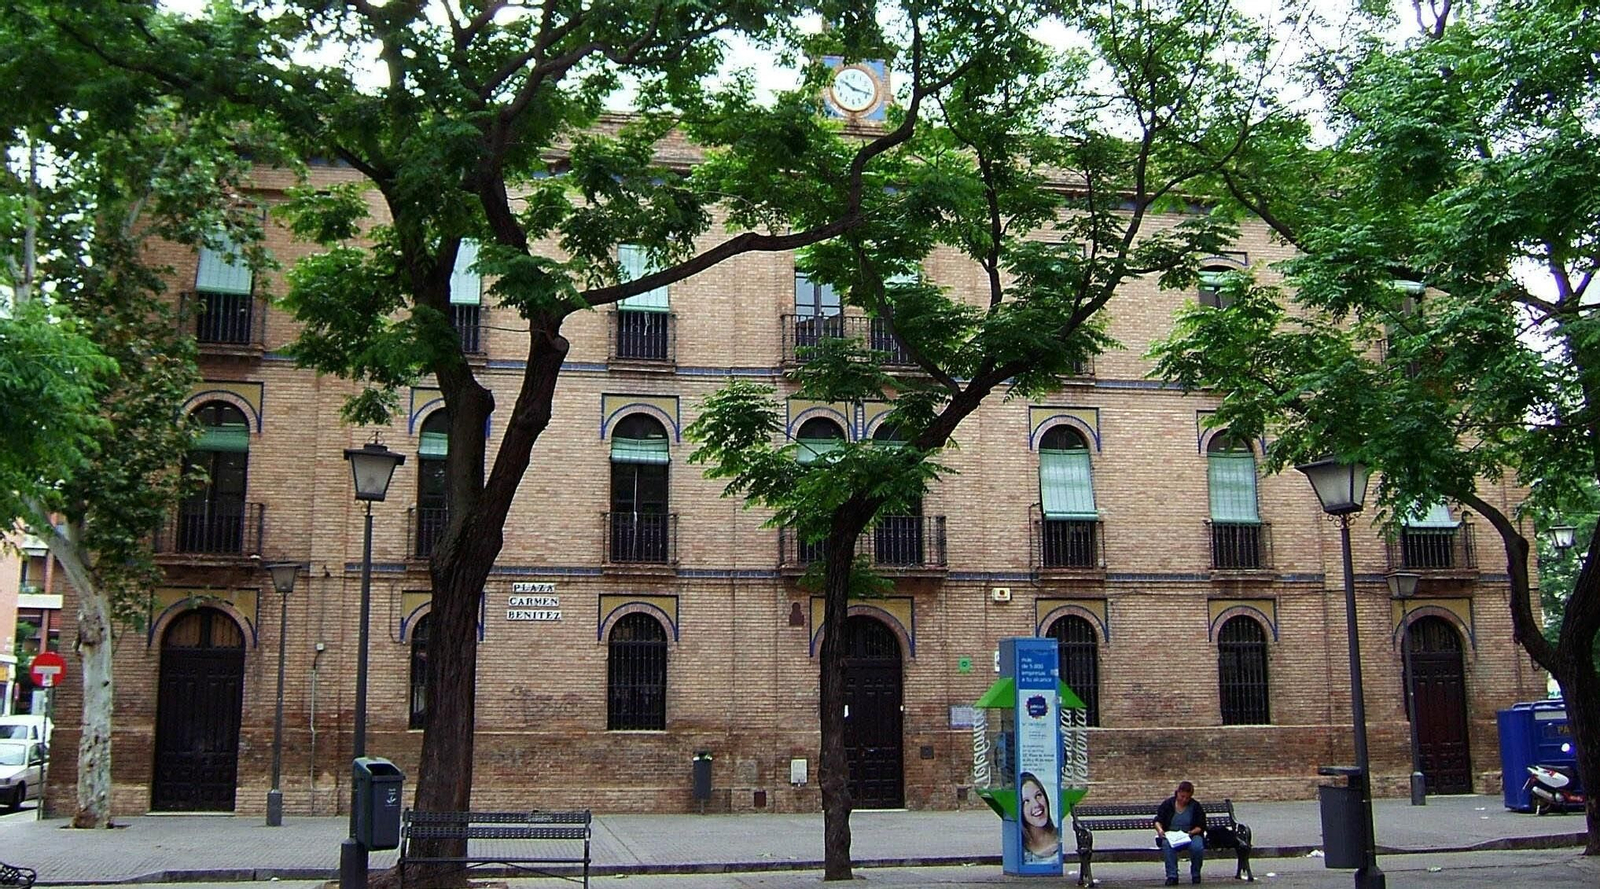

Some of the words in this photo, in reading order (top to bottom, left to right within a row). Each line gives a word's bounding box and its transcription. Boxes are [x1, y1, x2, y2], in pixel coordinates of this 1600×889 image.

[514, 584, 553, 592] PLAZA
[510, 597, 558, 605] CARMEN
[508, 611, 560, 619] BENITEZ
